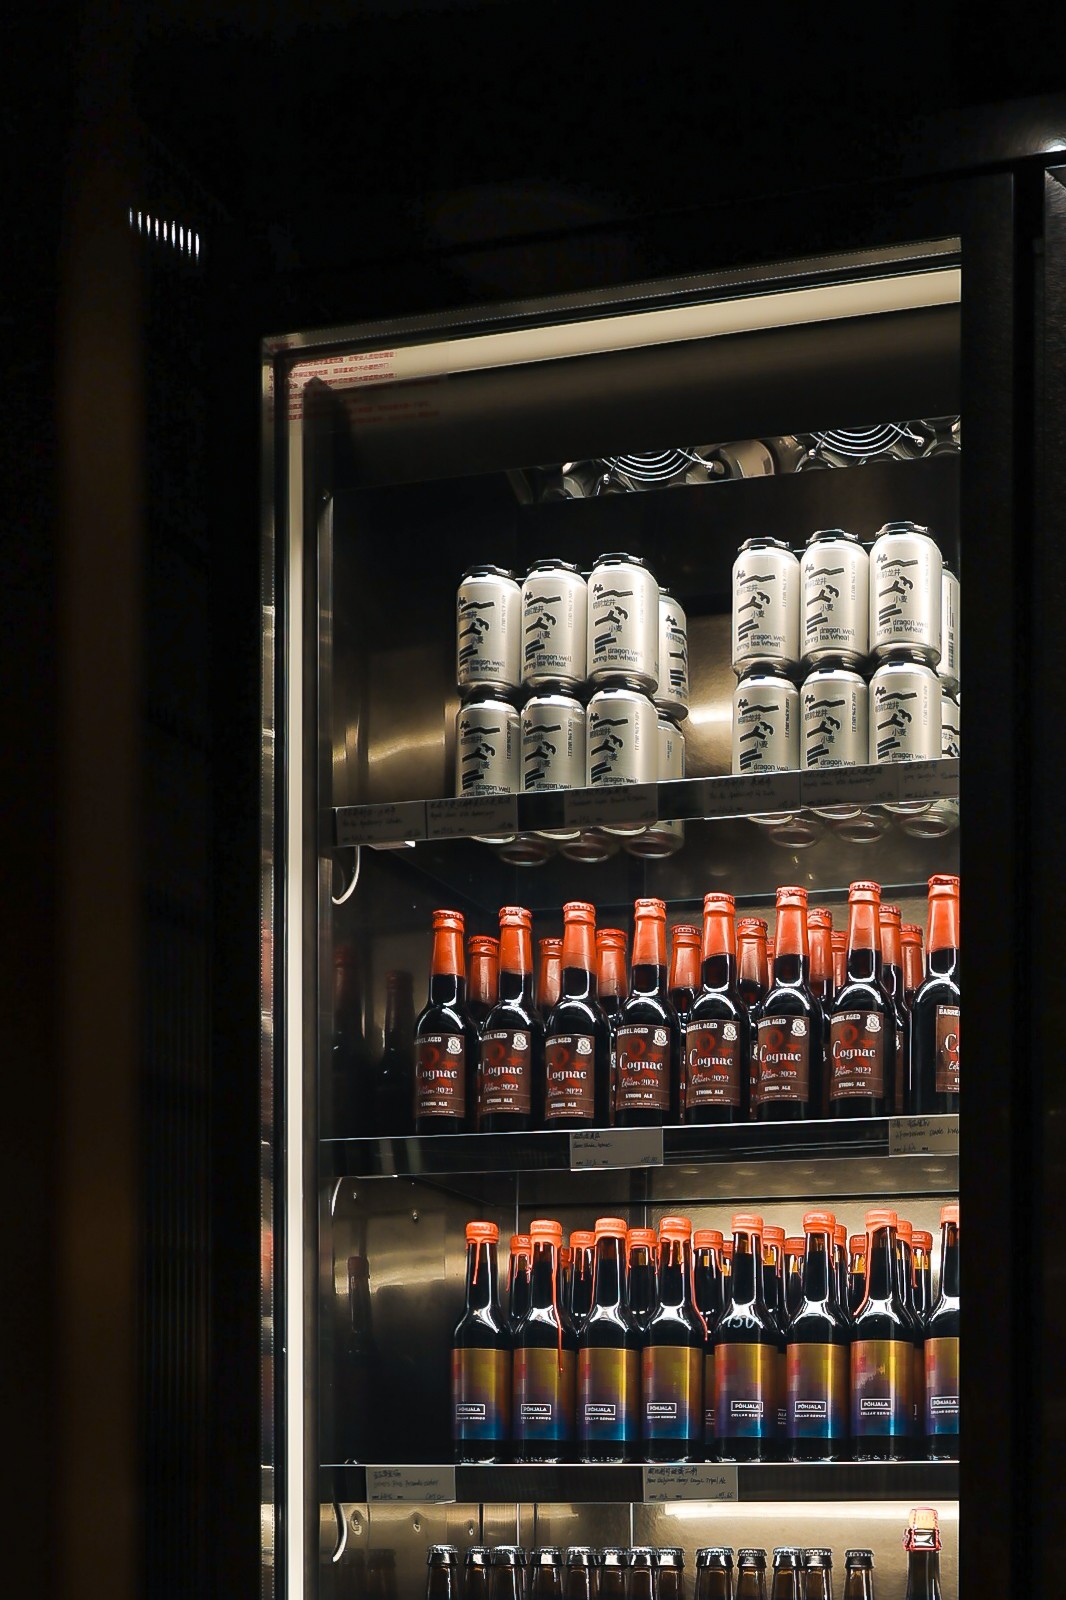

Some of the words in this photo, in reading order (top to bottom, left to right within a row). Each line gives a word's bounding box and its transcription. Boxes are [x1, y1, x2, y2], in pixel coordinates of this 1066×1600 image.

[820, 627, 839, 636] dragon
[537, 653, 557, 661] dragon
[690, 1049, 733, 1067] Cognac
[760, 1045, 801, 1063] Cognac
[833, 1041, 876, 1059] Cognac
[415, 1059, 457, 1080] Cognac
[482, 1057, 523, 1076] Cognac
[620, 1052, 663, 1071] Cognac
[547, 1062, 587, 1080] Cognac
